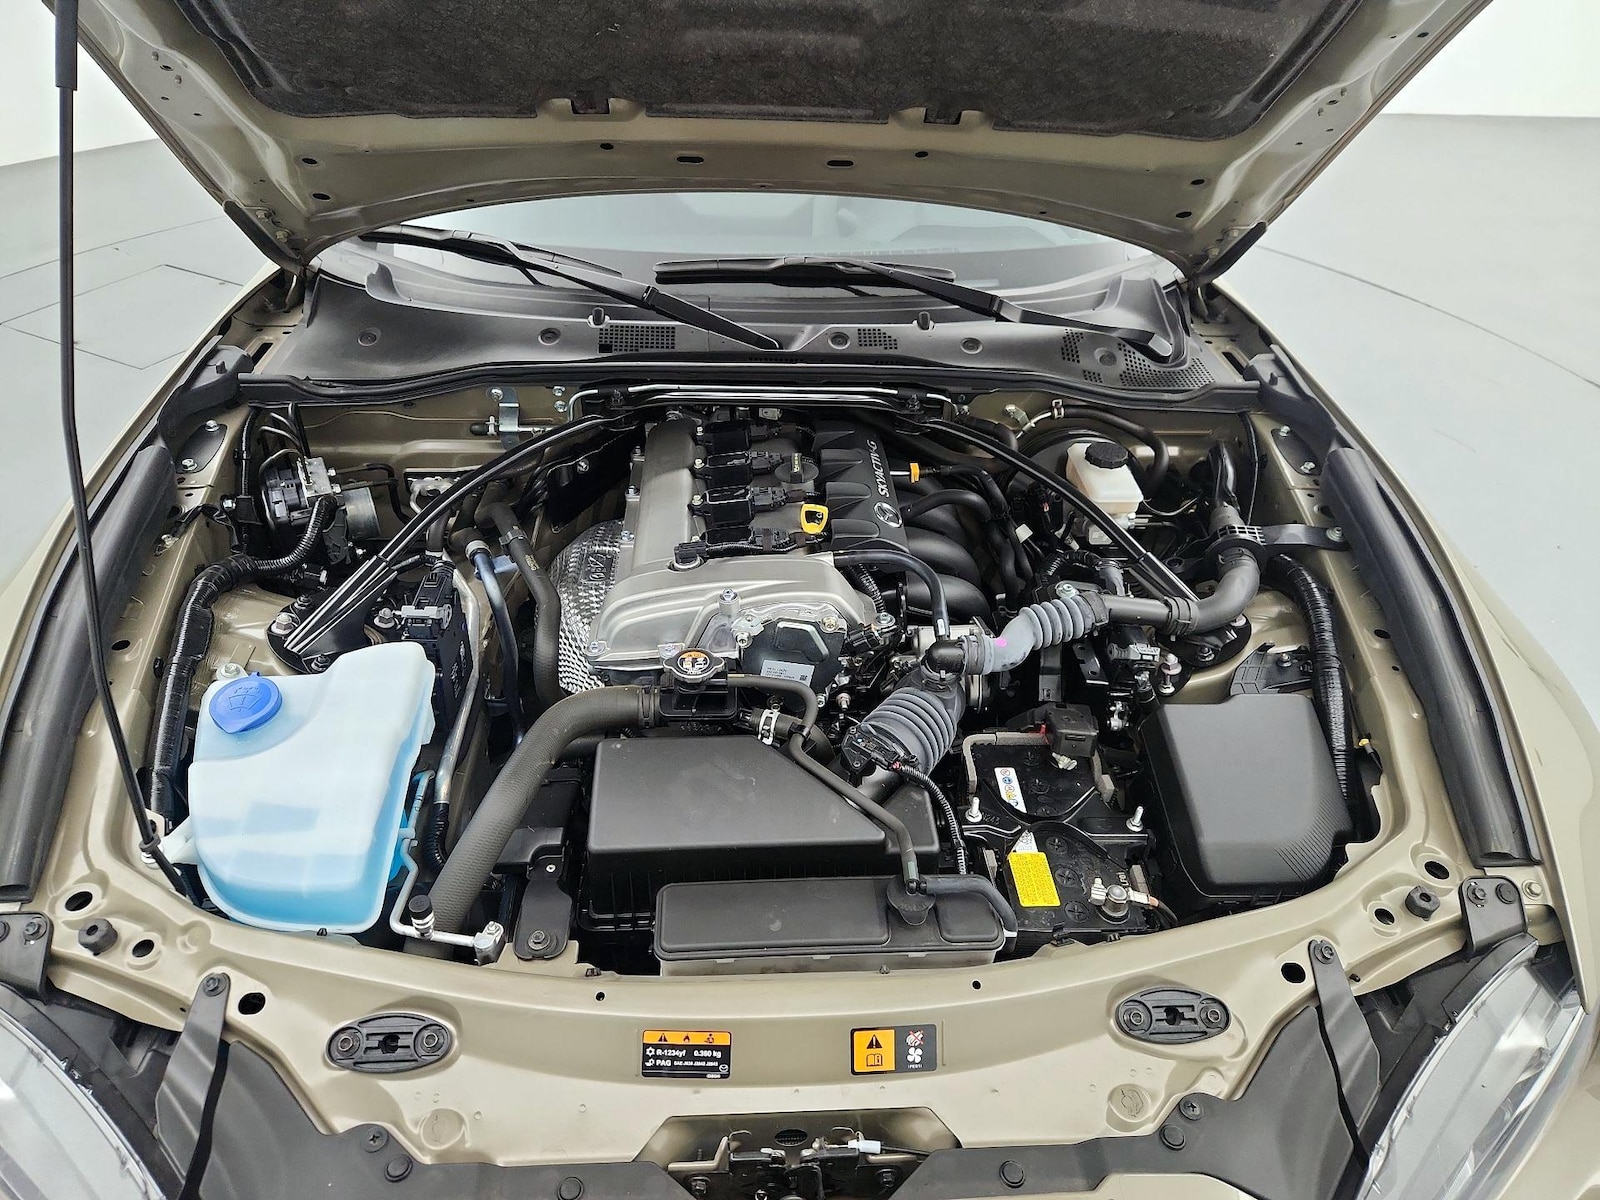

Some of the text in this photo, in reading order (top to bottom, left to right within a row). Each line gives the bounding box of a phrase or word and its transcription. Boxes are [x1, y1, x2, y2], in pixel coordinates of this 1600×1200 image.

[866, 439, 890, 498] SKYACTIV-G
[656, 1048, 686, 1058] R-1234yf
[713, 1050, 722, 1059] kg
[656, 1059, 672, 1067] PAG
